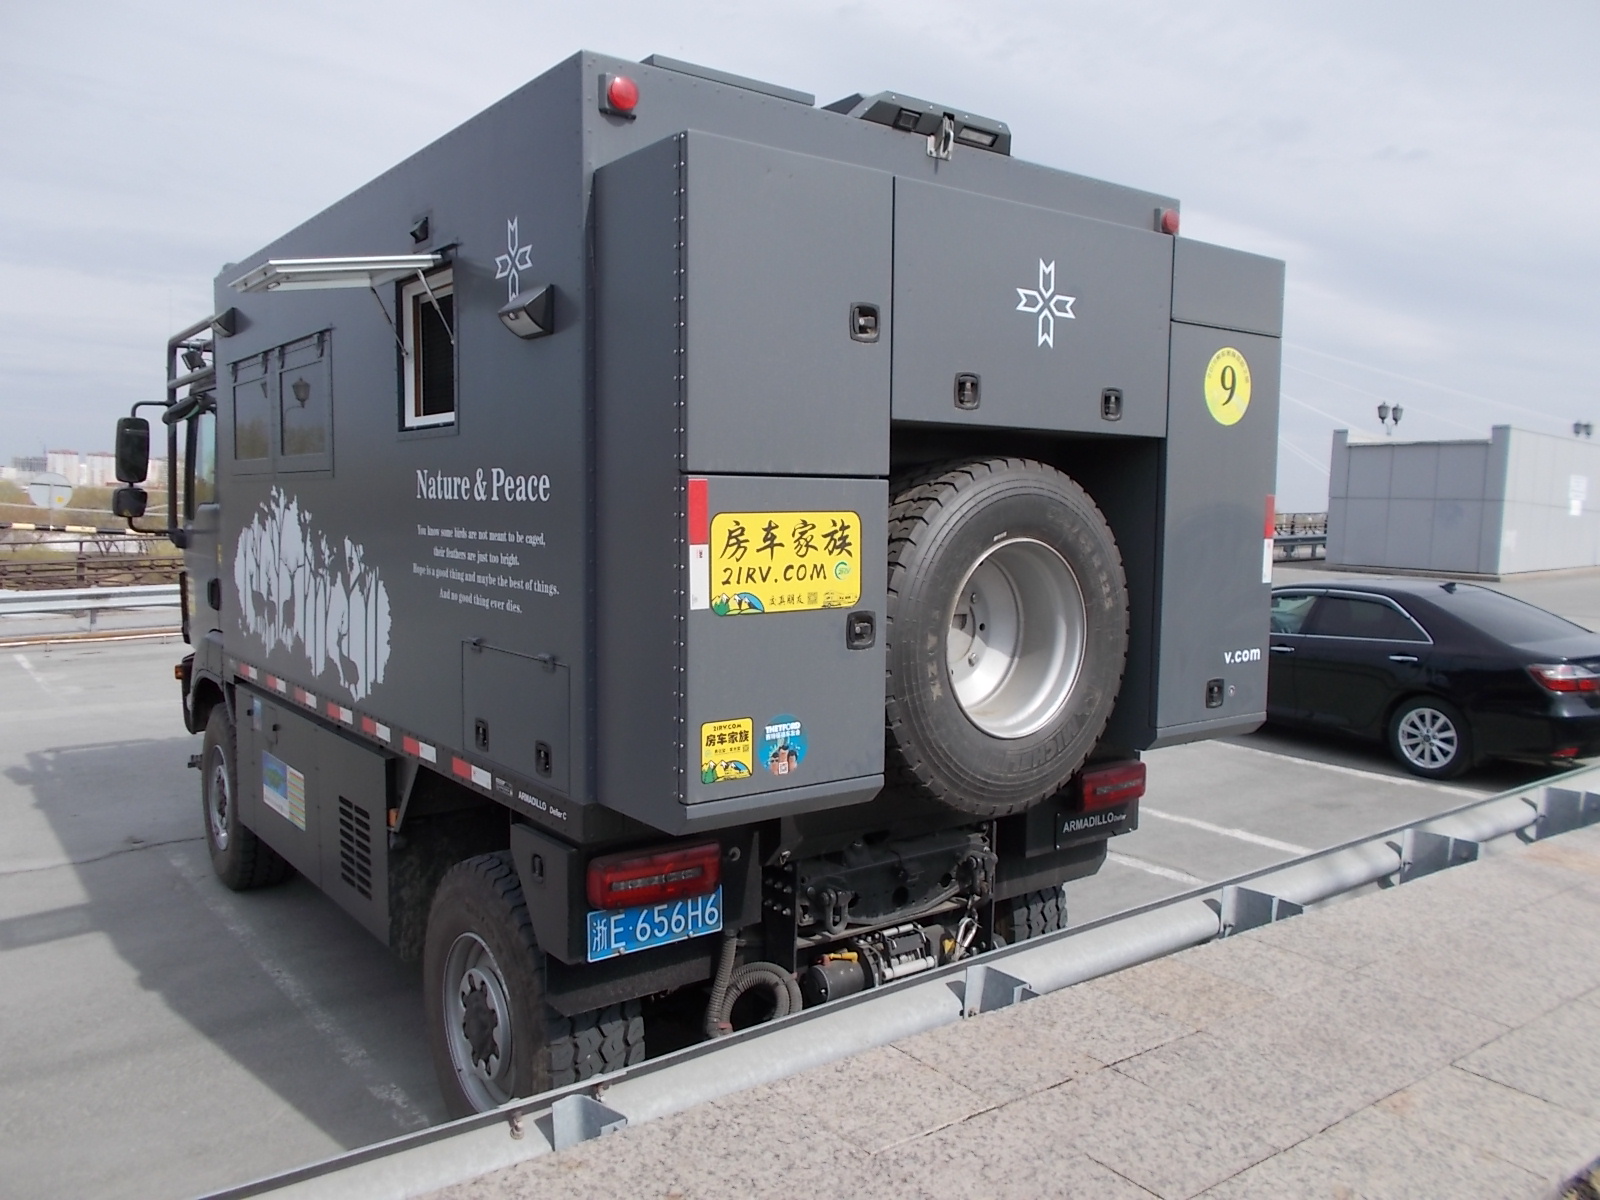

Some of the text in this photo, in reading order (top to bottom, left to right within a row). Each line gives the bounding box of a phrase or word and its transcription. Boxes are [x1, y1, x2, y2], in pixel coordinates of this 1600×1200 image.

[1220, 365, 1237, 407] 9
[416, 468, 550, 501] Nature & Peace
[417, 524, 545, 547] You know some birds are not meant to be caged,
[719, 519, 853, 562] 房车家族
[434, 546, 519, 567] their feathers are just too bright.
[413, 563, 426, 576] Hope
[436, 568, 448, 578] good
[450, 569, 464, 582] thing
[465, 571, 475, 582] and
[477, 574, 496, 586] maybe
[498, 575, 507, 587] the
[509, 577, 524, 589] best
[525, 579, 533, 591] of
[534, 580, 560, 596] things.
[440, 588, 522, 613] And no good thing ever dies.
[1224, 648, 1261, 664] v.com
[706, 730, 749, 747] 房车家族
[518, 790, 547, 811] ARMADILLO
[1062, 812, 1114, 833] ARMADILLO
